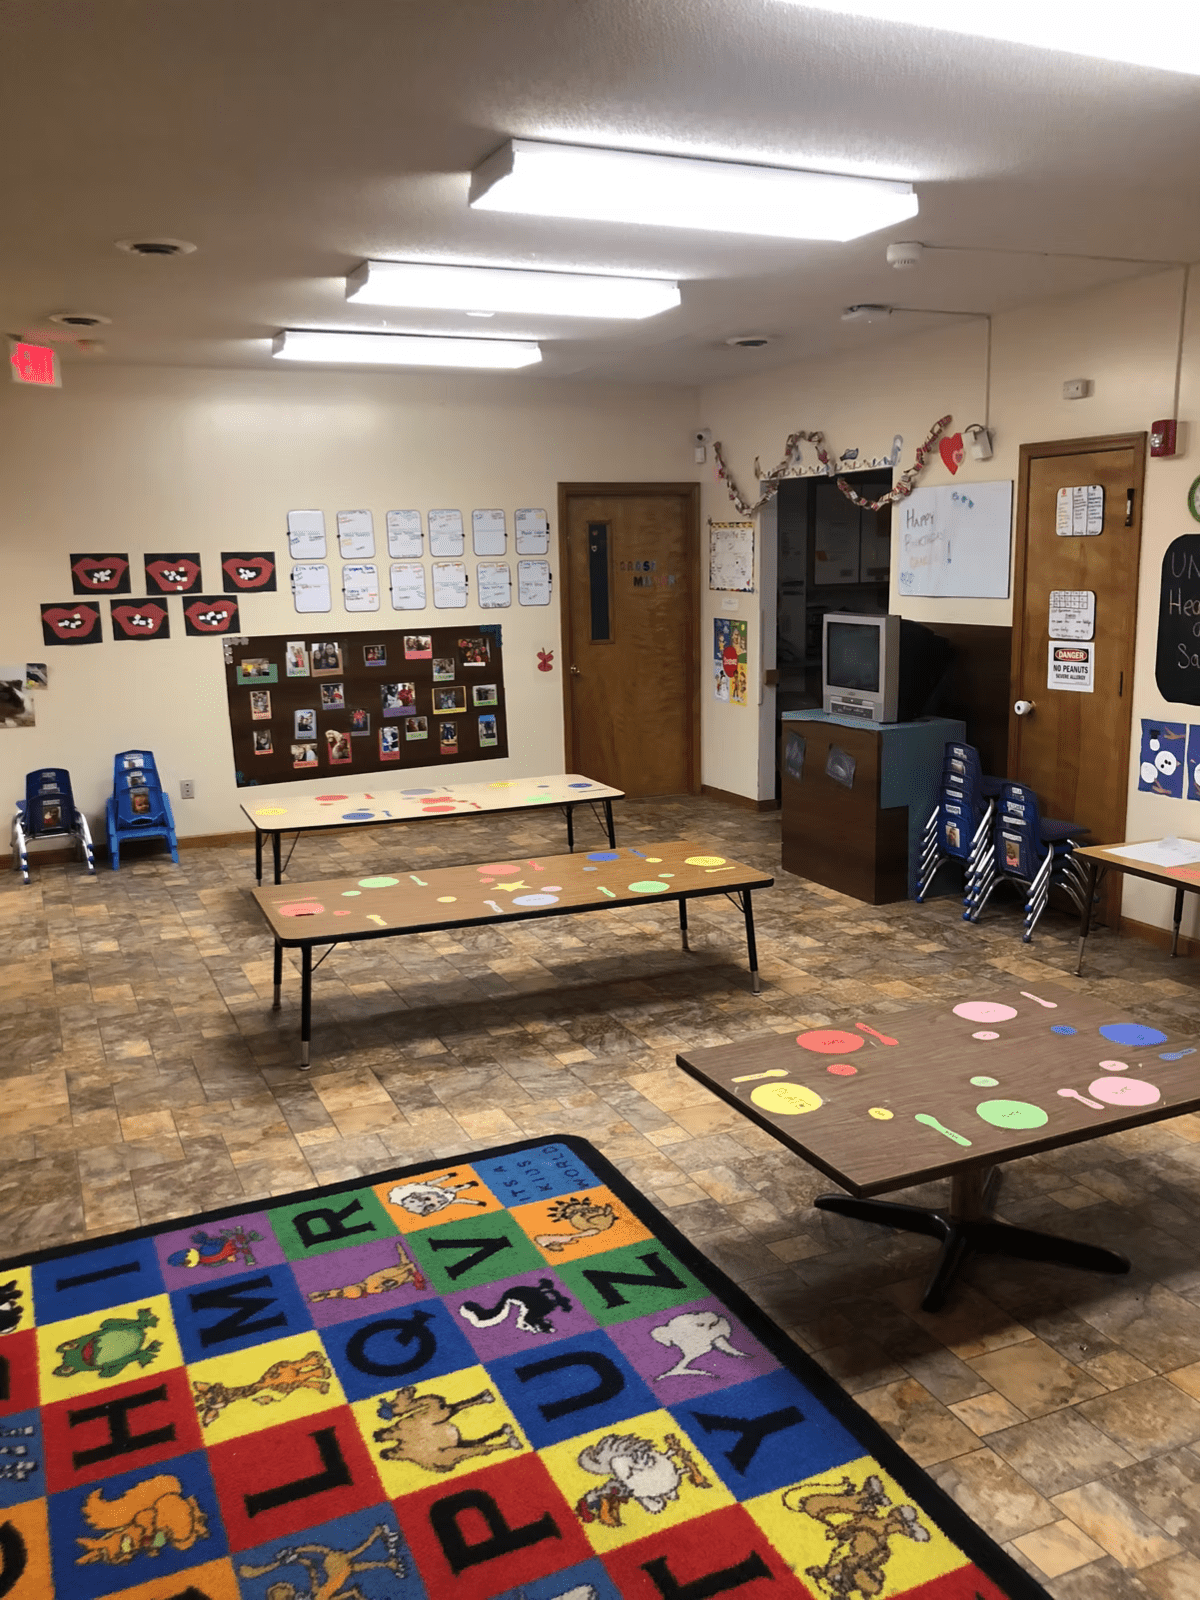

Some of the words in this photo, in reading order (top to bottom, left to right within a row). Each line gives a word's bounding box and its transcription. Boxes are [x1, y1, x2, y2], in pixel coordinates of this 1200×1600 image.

[1053, 664, 1062, 672] NO
[1062, 664, 1089, 674] PEANUTS
[1058, 650, 1085, 660] DANGER
[503, 1179, 531, 1202] ITS
[541, 1145, 589, 1190] WORLD
[292, 1198, 376, 1249] R
[55, 1261, 140, 1292] I
[427, 1235, 513, 1281] V
[583, 1251, 688, 1309] Z
[189, 1275, 288, 1348] M
[346, 1310, 437, 1378] Q
[515, 1351, 625, 1422] U
[69, 1385, 176, 1470] H
[692, 1405, 805, 1475] Y
[244, 1427, 352, 1519] L
[429, 1489, 562, 1576] P
